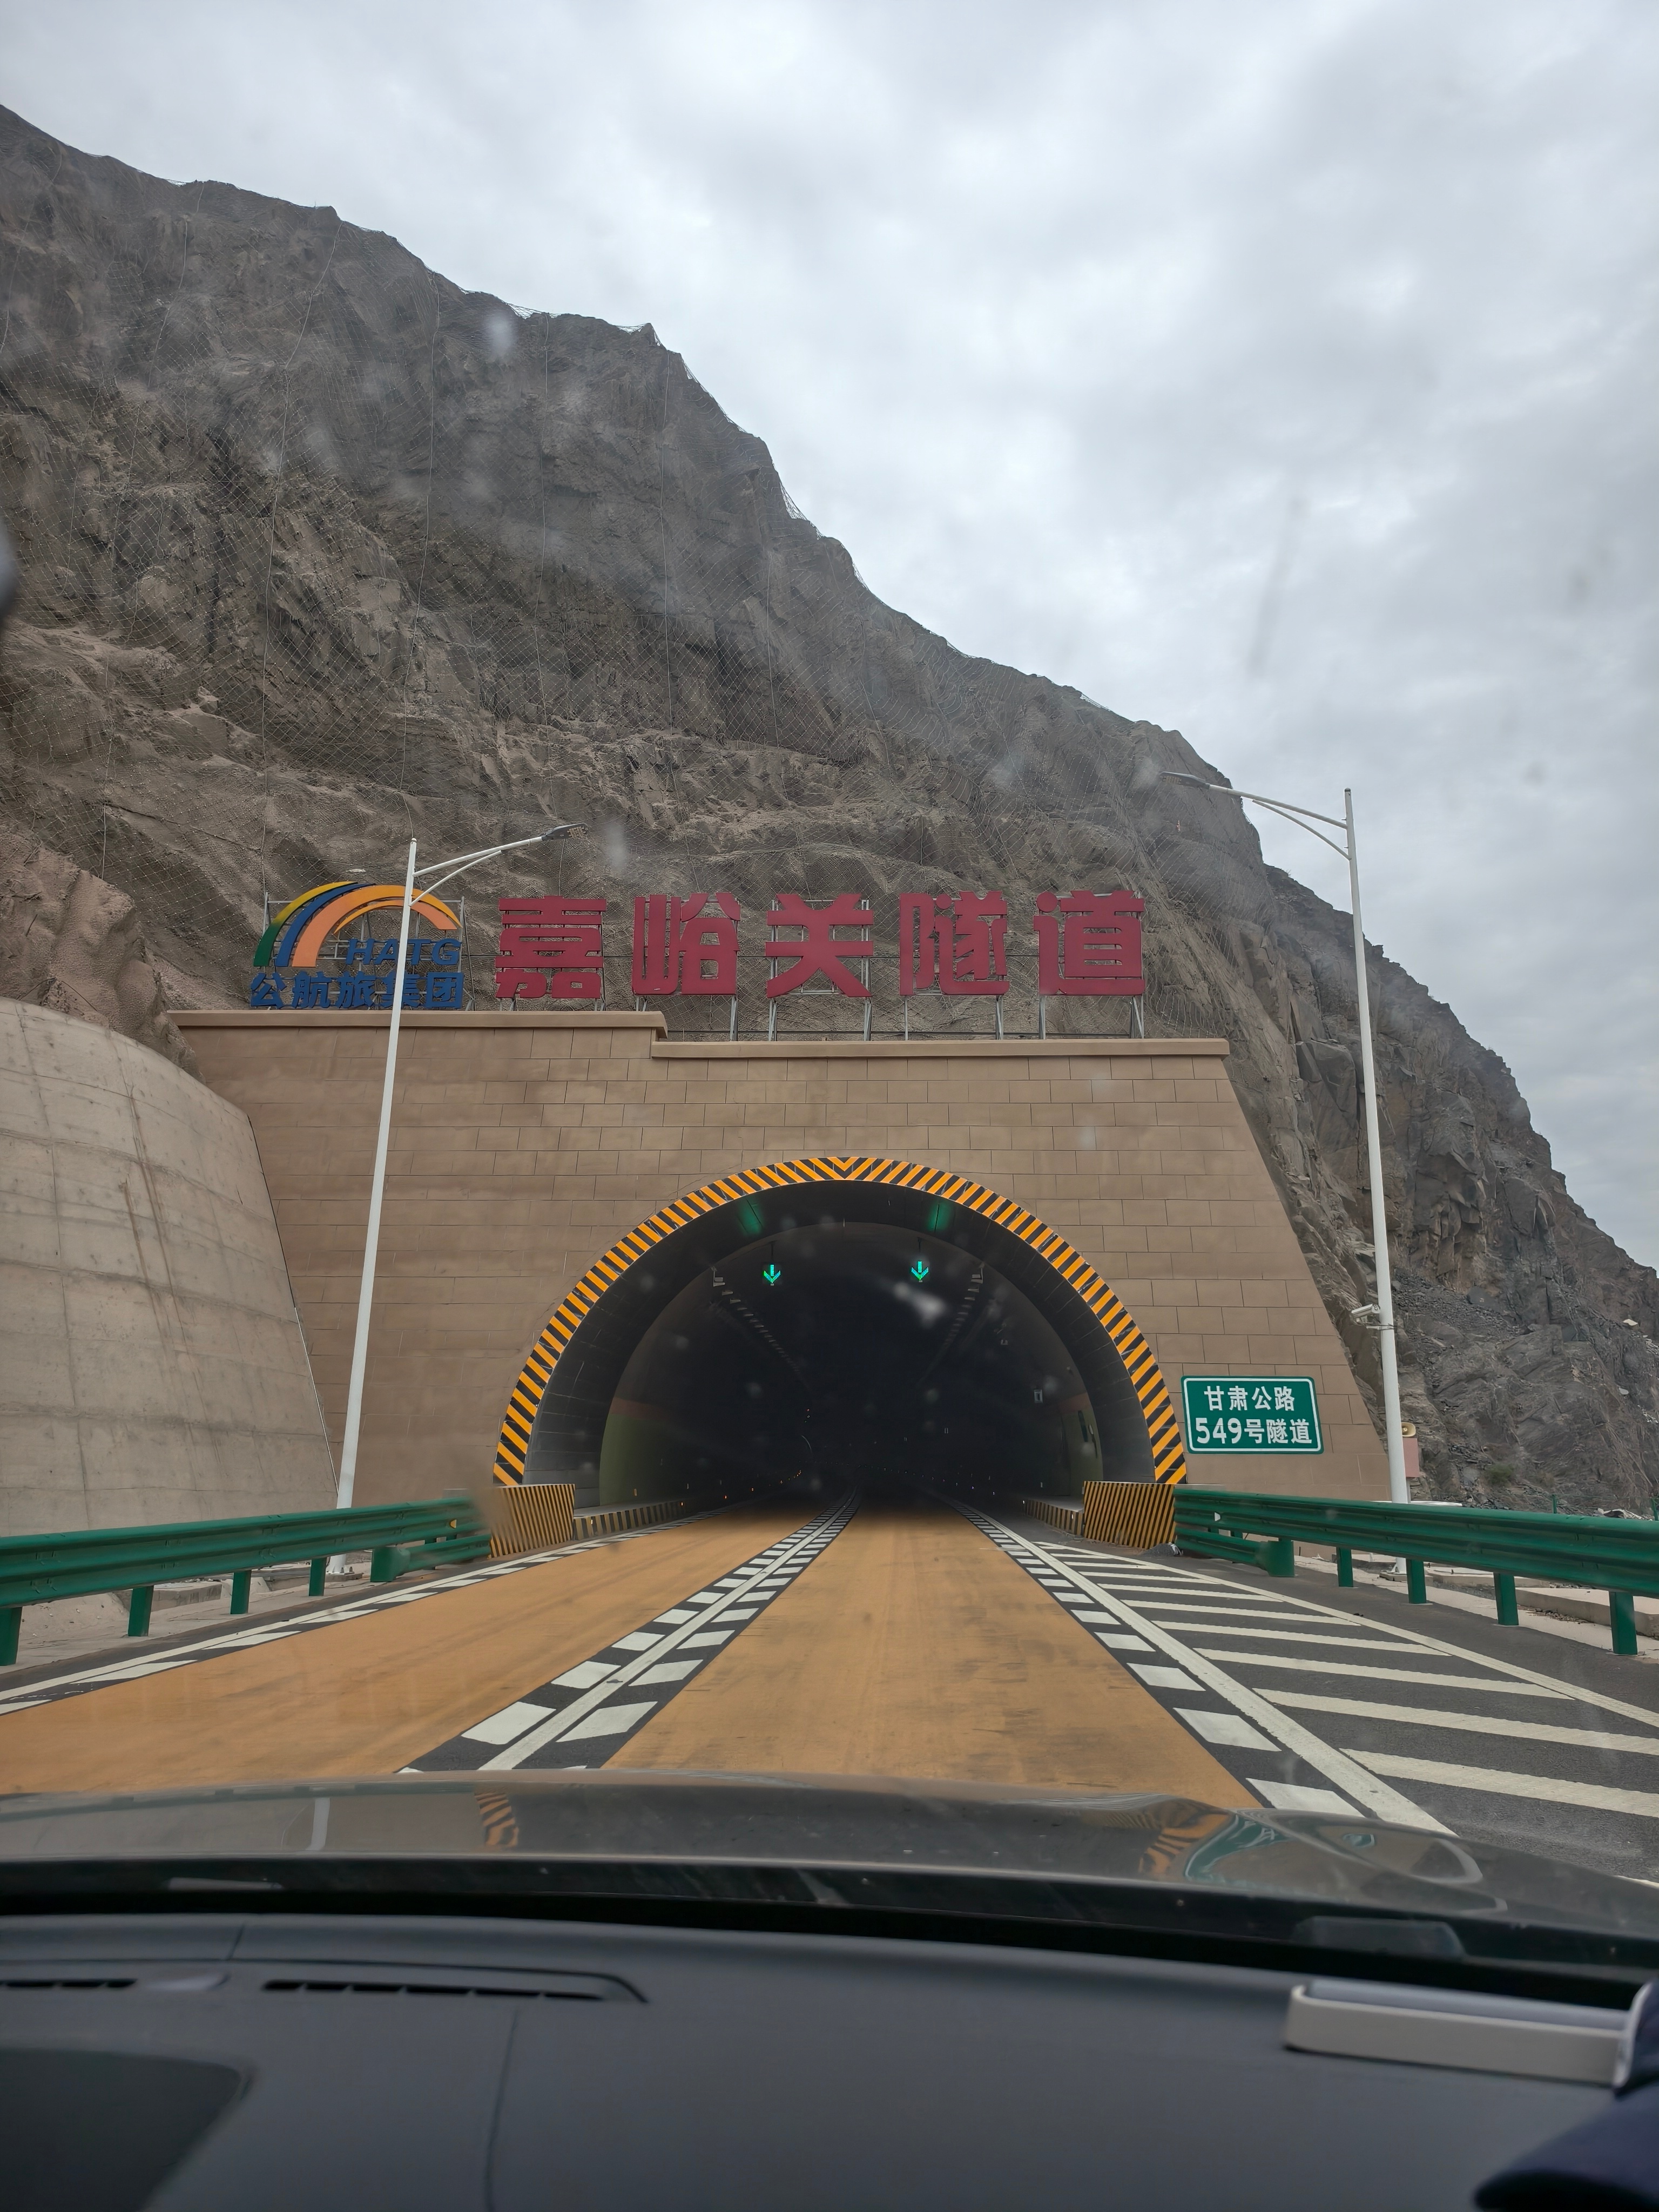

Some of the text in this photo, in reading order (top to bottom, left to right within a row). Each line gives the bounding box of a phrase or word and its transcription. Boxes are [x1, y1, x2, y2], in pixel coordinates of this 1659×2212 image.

[346, 938, 462, 965] HATG
[495, 890, 1145, 999] 嘉峪关隧道
[250, 970, 464, 1009] 公航旅集团
[1204, 1385, 1295, 1411] 甘肃公路
[1195, 1417, 1312, 1444] 549号隧道
